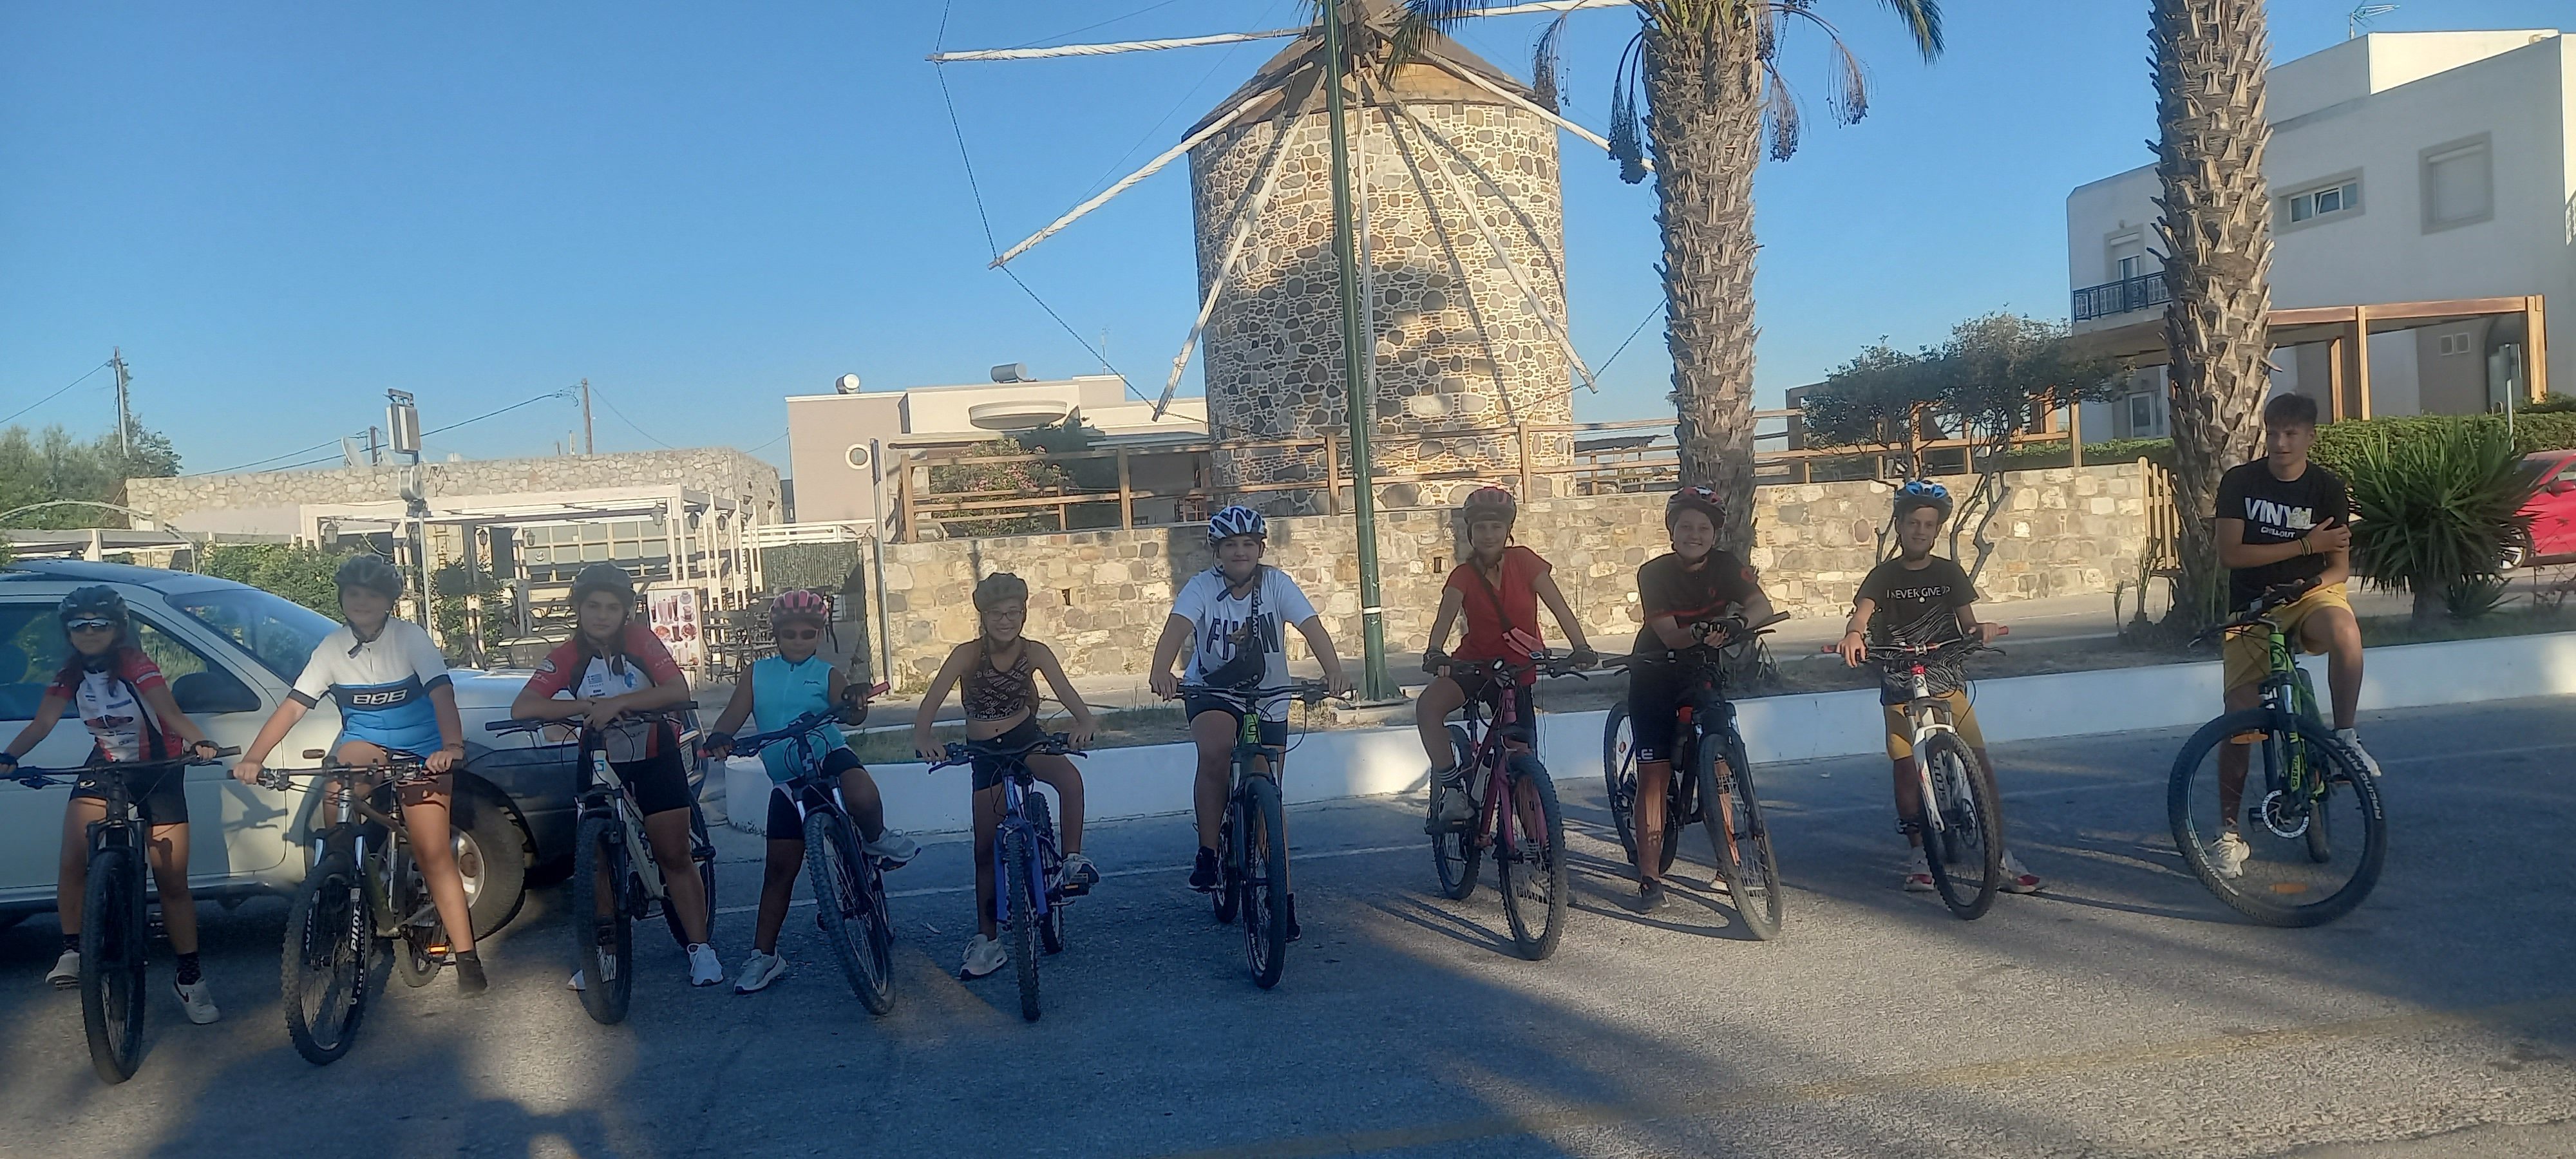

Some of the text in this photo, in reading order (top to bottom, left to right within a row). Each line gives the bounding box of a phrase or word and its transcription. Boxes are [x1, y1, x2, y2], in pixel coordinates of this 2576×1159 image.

[2260, 526, 2295, 538] CHILLOUT
[1921, 586, 1942, 597] GIVE
[353, 690, 408, 705] BBB
